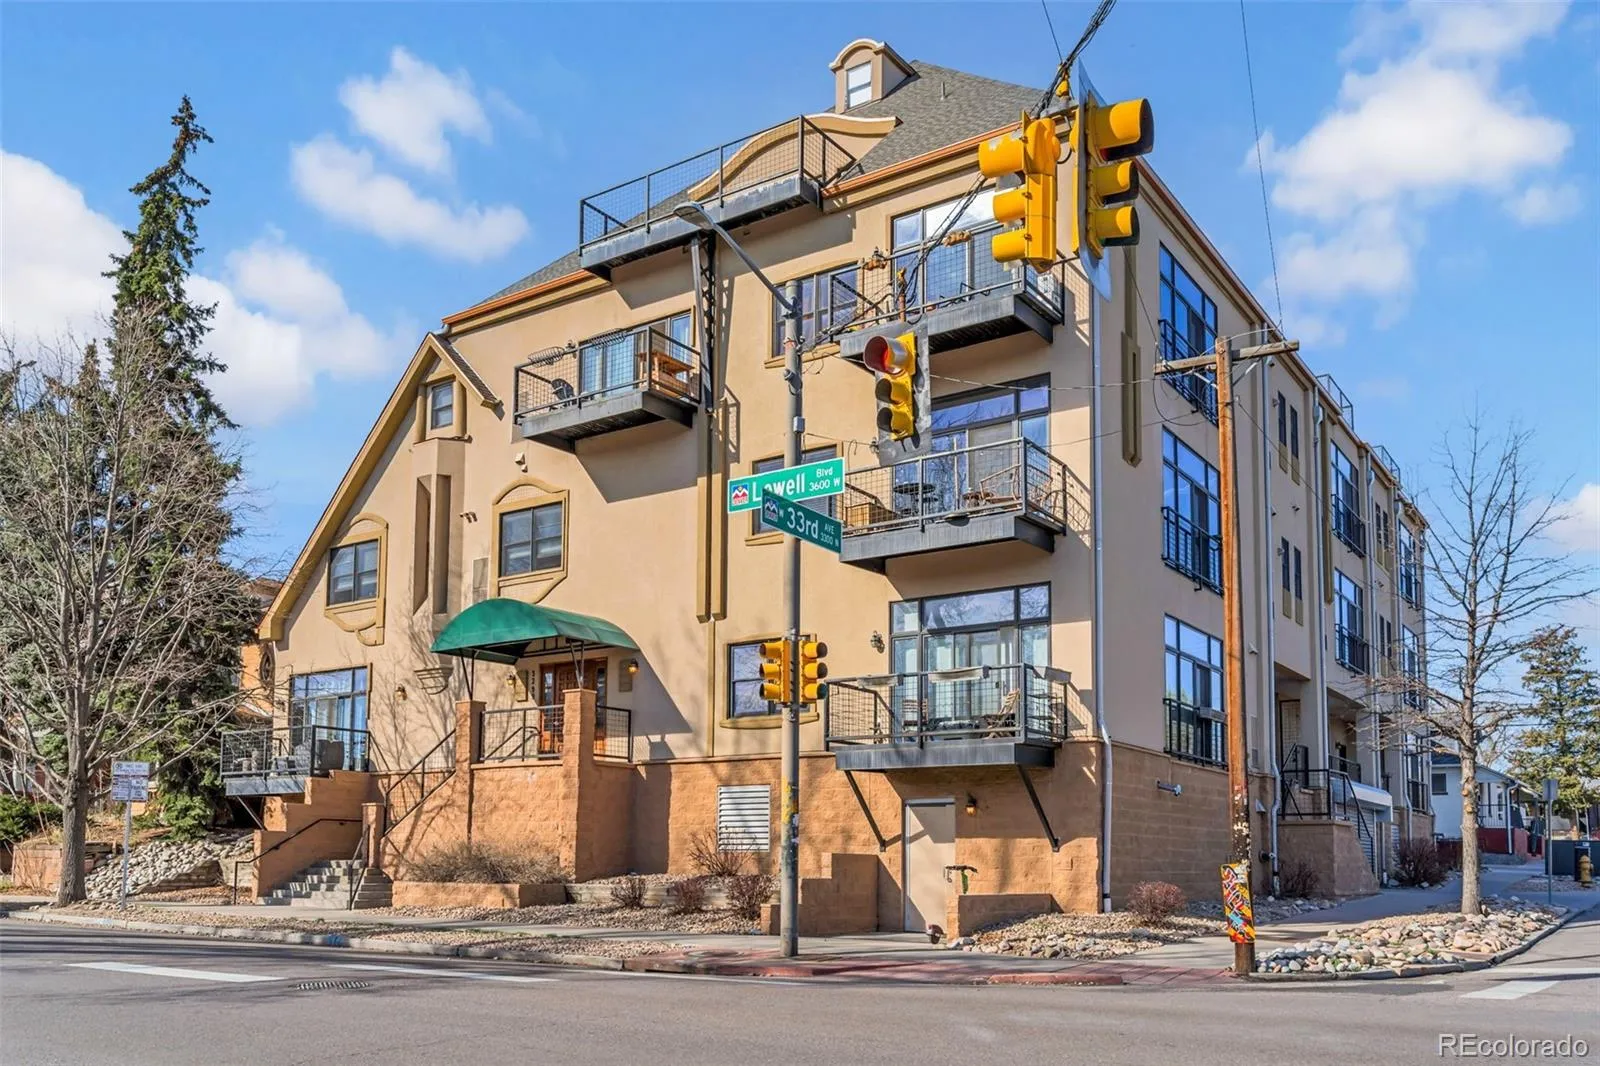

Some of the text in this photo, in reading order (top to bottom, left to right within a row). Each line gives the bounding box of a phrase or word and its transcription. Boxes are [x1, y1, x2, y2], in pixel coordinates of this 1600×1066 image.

[816, 466, 834, 478] Blvd
[808, 477, 841, 492] 3600 W
[786, 507, 819, 540] 33rd
[824, 523, 836, 535] AVE
